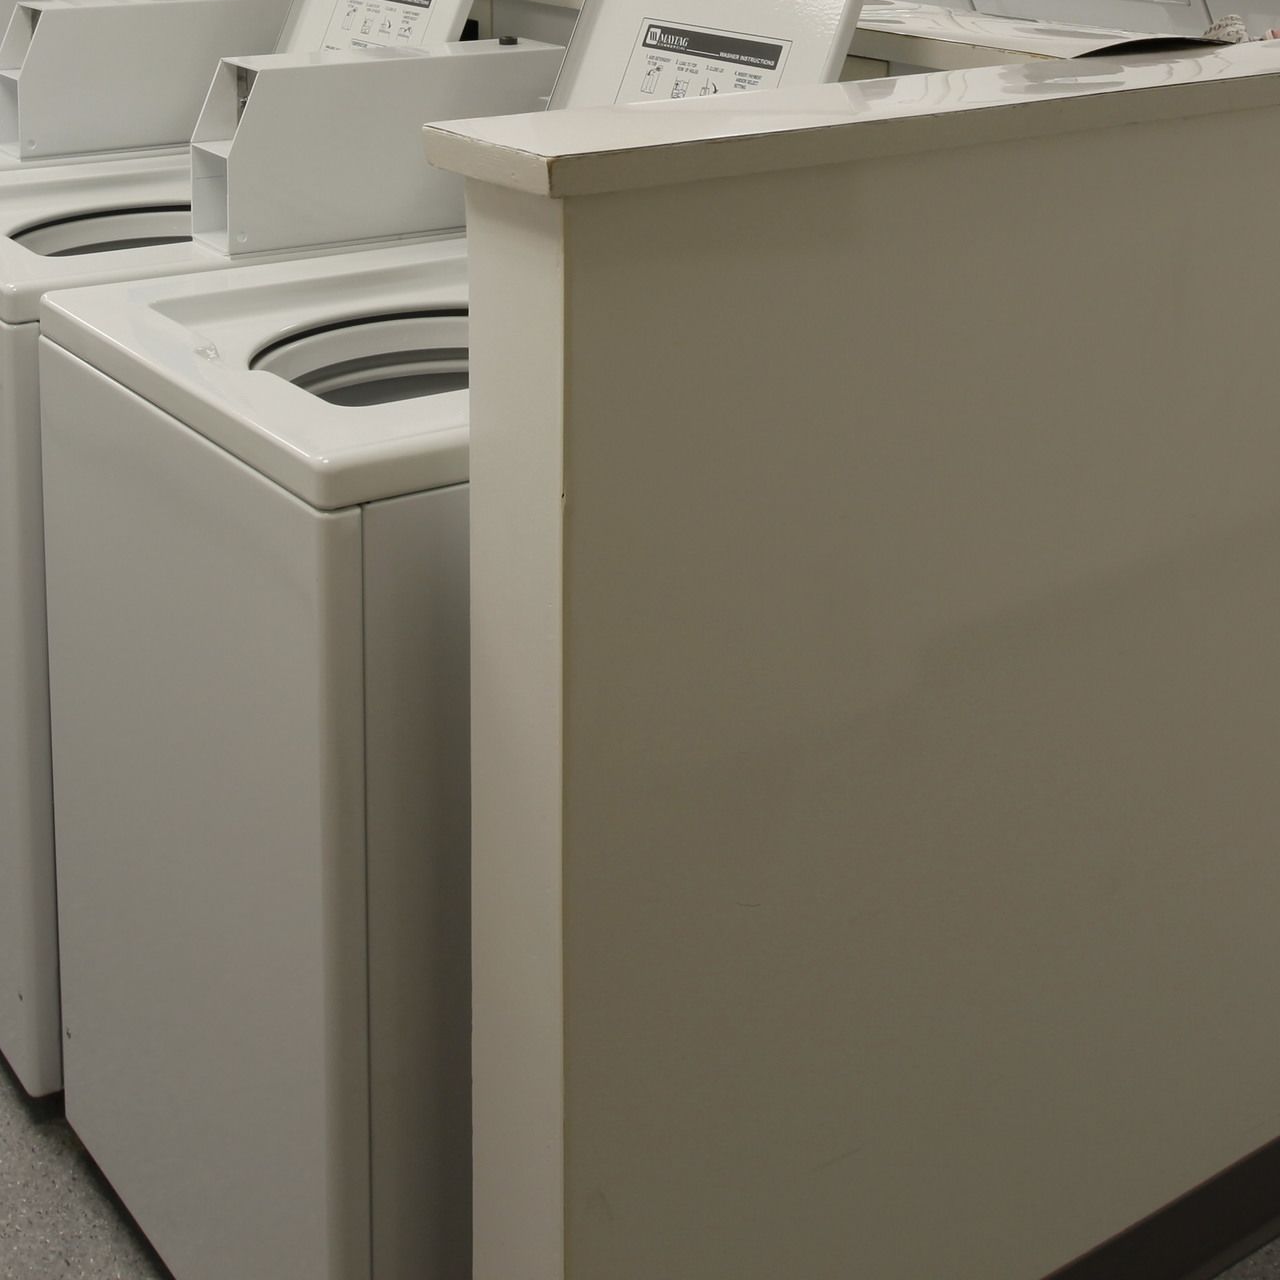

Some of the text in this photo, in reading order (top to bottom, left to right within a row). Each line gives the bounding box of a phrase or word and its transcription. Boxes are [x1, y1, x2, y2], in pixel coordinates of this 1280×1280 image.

[659, 32, 690, 47] MAYTAG
[719, 51, 775, 67] WASHER INSTRUCTIONS
